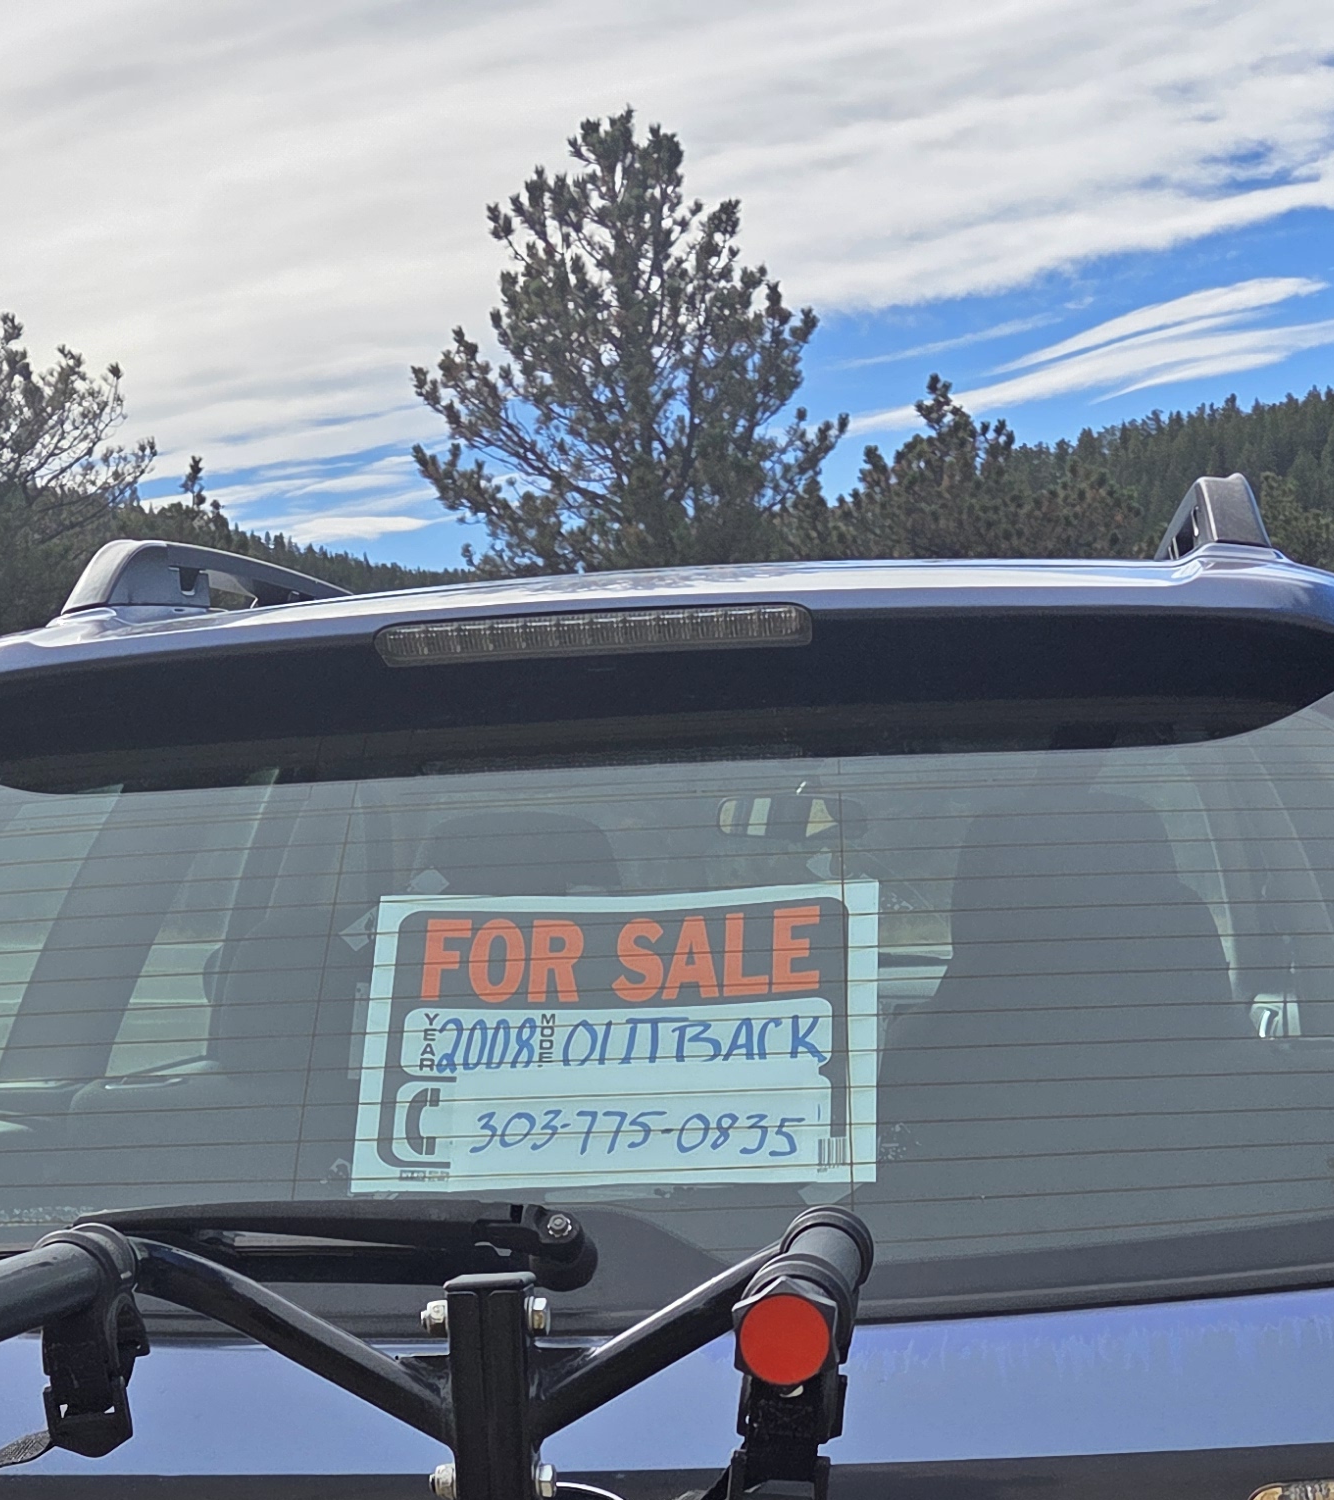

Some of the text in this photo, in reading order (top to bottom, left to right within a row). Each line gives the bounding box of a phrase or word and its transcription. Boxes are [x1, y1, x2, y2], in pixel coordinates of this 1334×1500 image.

[420, 904, 821, 1003] FOR SALE
[419, 1012, 440, 1072] YEAR
[435, 1014, 828, 1074] 2008 OUTBACK
[537, 1013, 556, 1068] MODE
[469, 1108, 806, 1157] 303-775-0835
